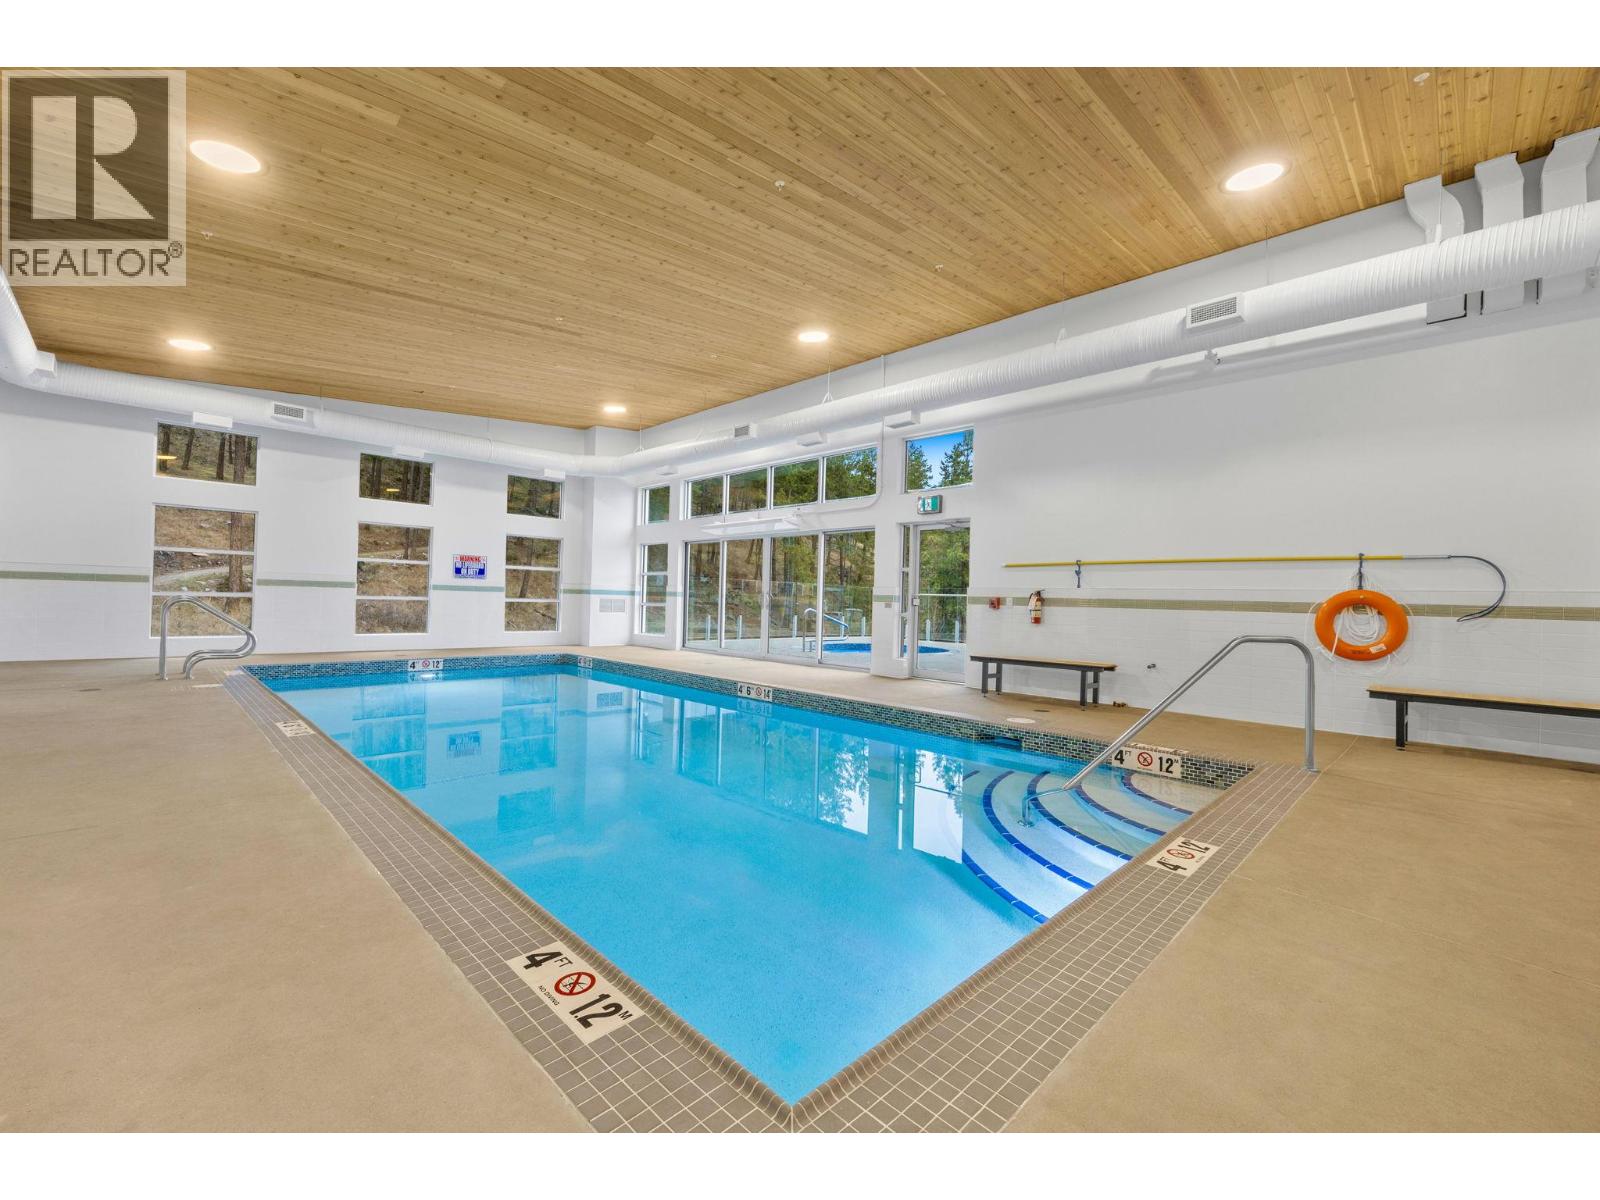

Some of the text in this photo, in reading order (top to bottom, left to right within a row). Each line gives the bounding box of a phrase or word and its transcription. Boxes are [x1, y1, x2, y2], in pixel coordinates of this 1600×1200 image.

[410, 661, 416, 669] 4
[1114, 749, 1125, 765] 4
[1156, 860, 1188, 872] 4
[523, 951, 574, 970] 4 FT
[538, 985, 547, 993] NO
[569, 993, 633, 1029] 1.2 M
